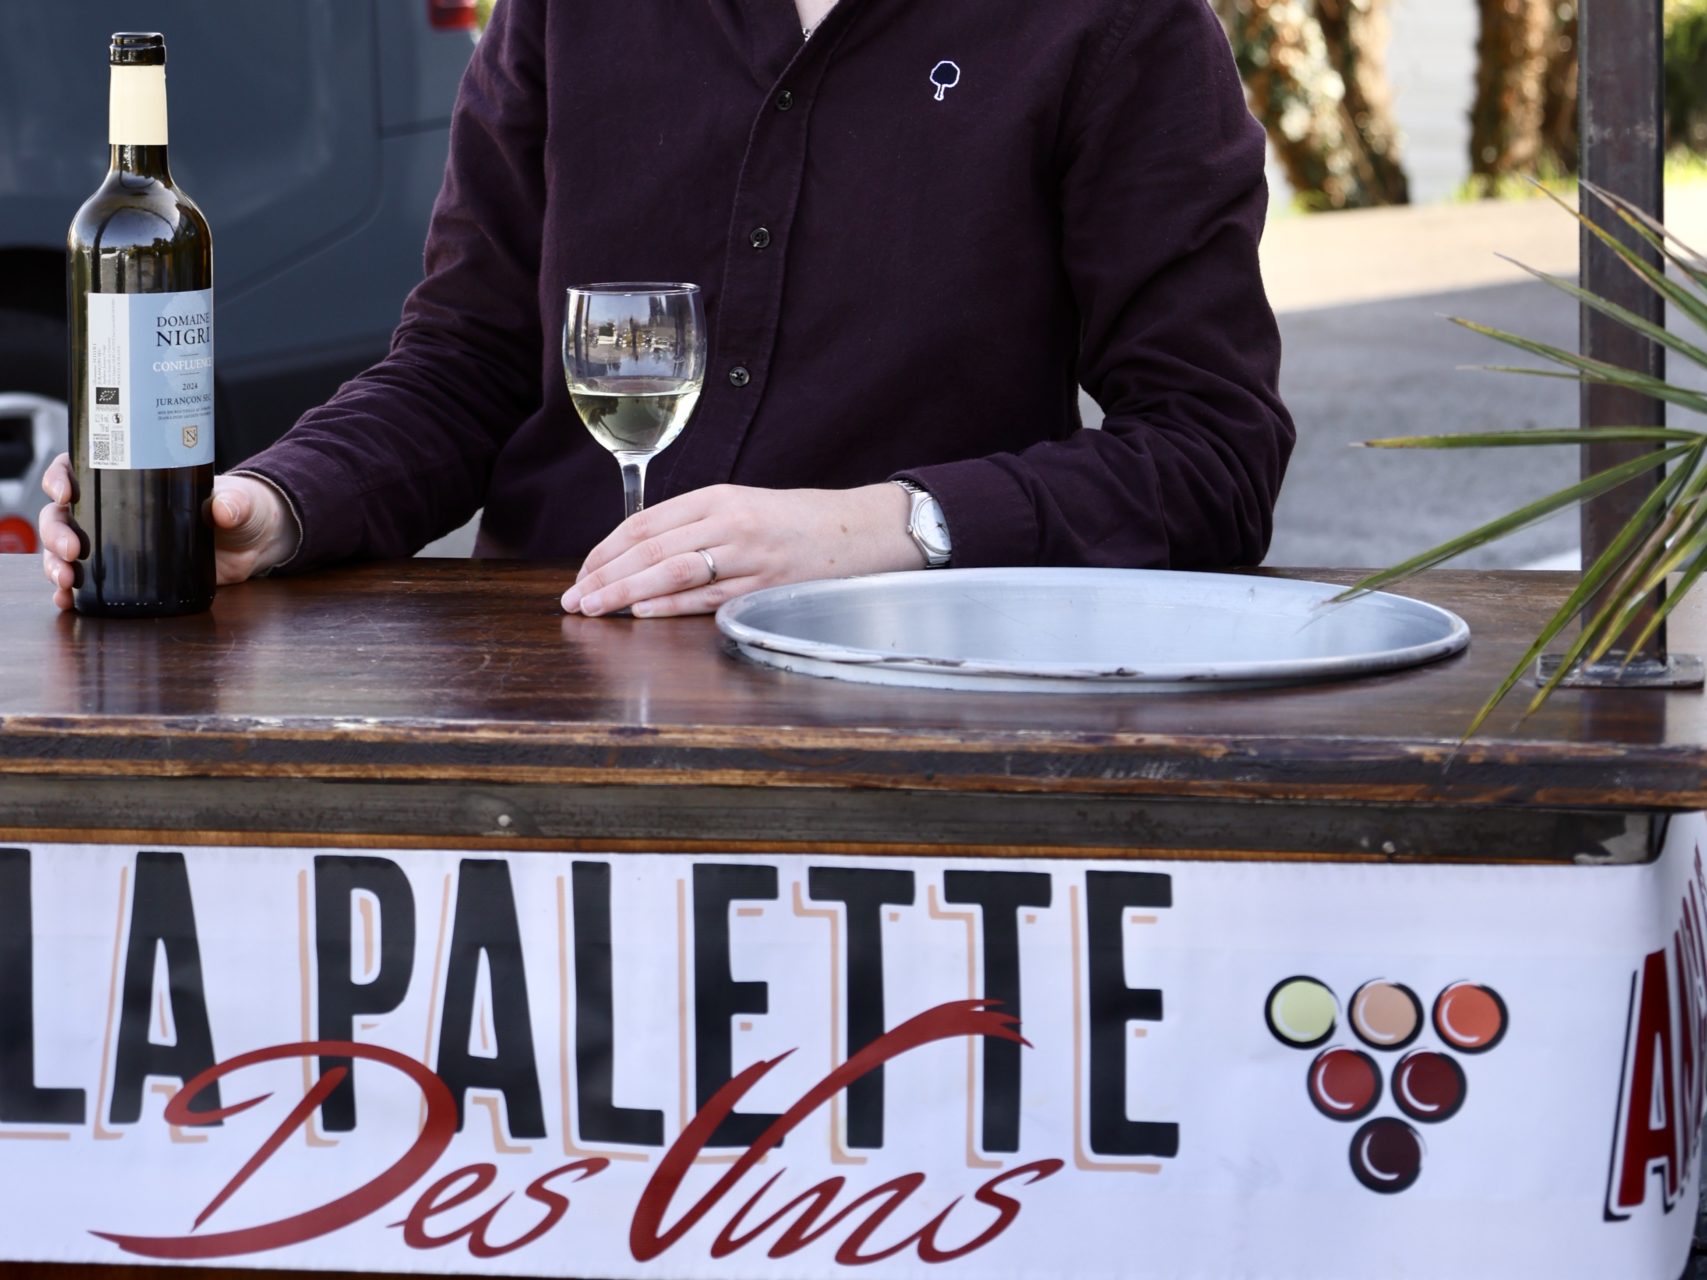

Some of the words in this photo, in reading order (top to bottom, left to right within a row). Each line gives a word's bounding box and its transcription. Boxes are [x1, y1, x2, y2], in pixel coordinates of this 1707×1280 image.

[157, 312, 210, 328] DOMAINE
[156, 326, 210, 347] NIGRI
[156, 395, 201, 409] JURANÇON
[0, 848, 223, 1127] LA
[313, 855, 1179, 1158] PALETTE
[87, 1040, 610, 1260] Des
[629, 998, 1065, 1266] Vins
